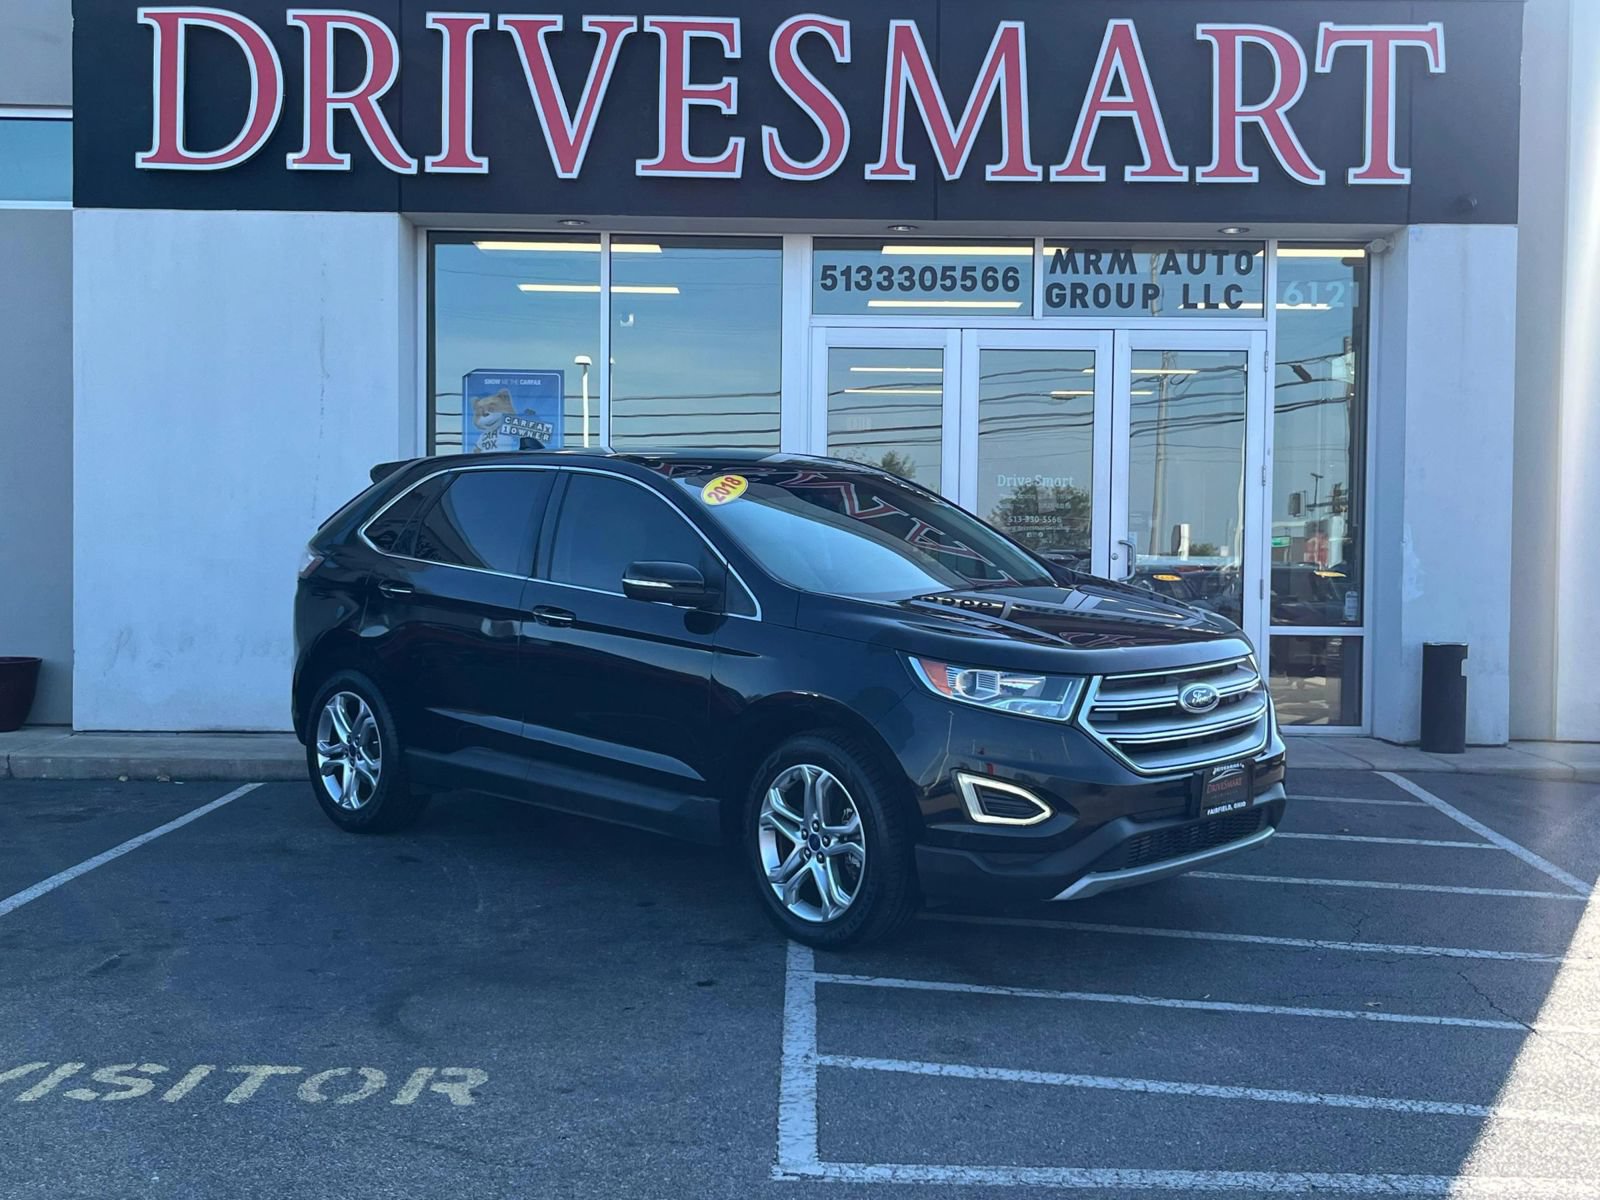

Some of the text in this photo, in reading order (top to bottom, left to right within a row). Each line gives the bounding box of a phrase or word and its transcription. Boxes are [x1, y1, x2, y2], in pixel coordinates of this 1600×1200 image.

[134, 5, 1447, 188] DRIVESMART
[1048, 248, 1252, 276] MRM AUTO
[820, 264, 1020, 293] 5133305566
[1045, 282, 1244, 309] GROUP LLC
[504, 416, 553, 434] CARFAX
[511, 427, 550, 441] OWNER
[707, 476, 743, 503] 2018
[997, 474, 1074, 487] Drive Smart
[1191, 689, 1213, 704] Ford
